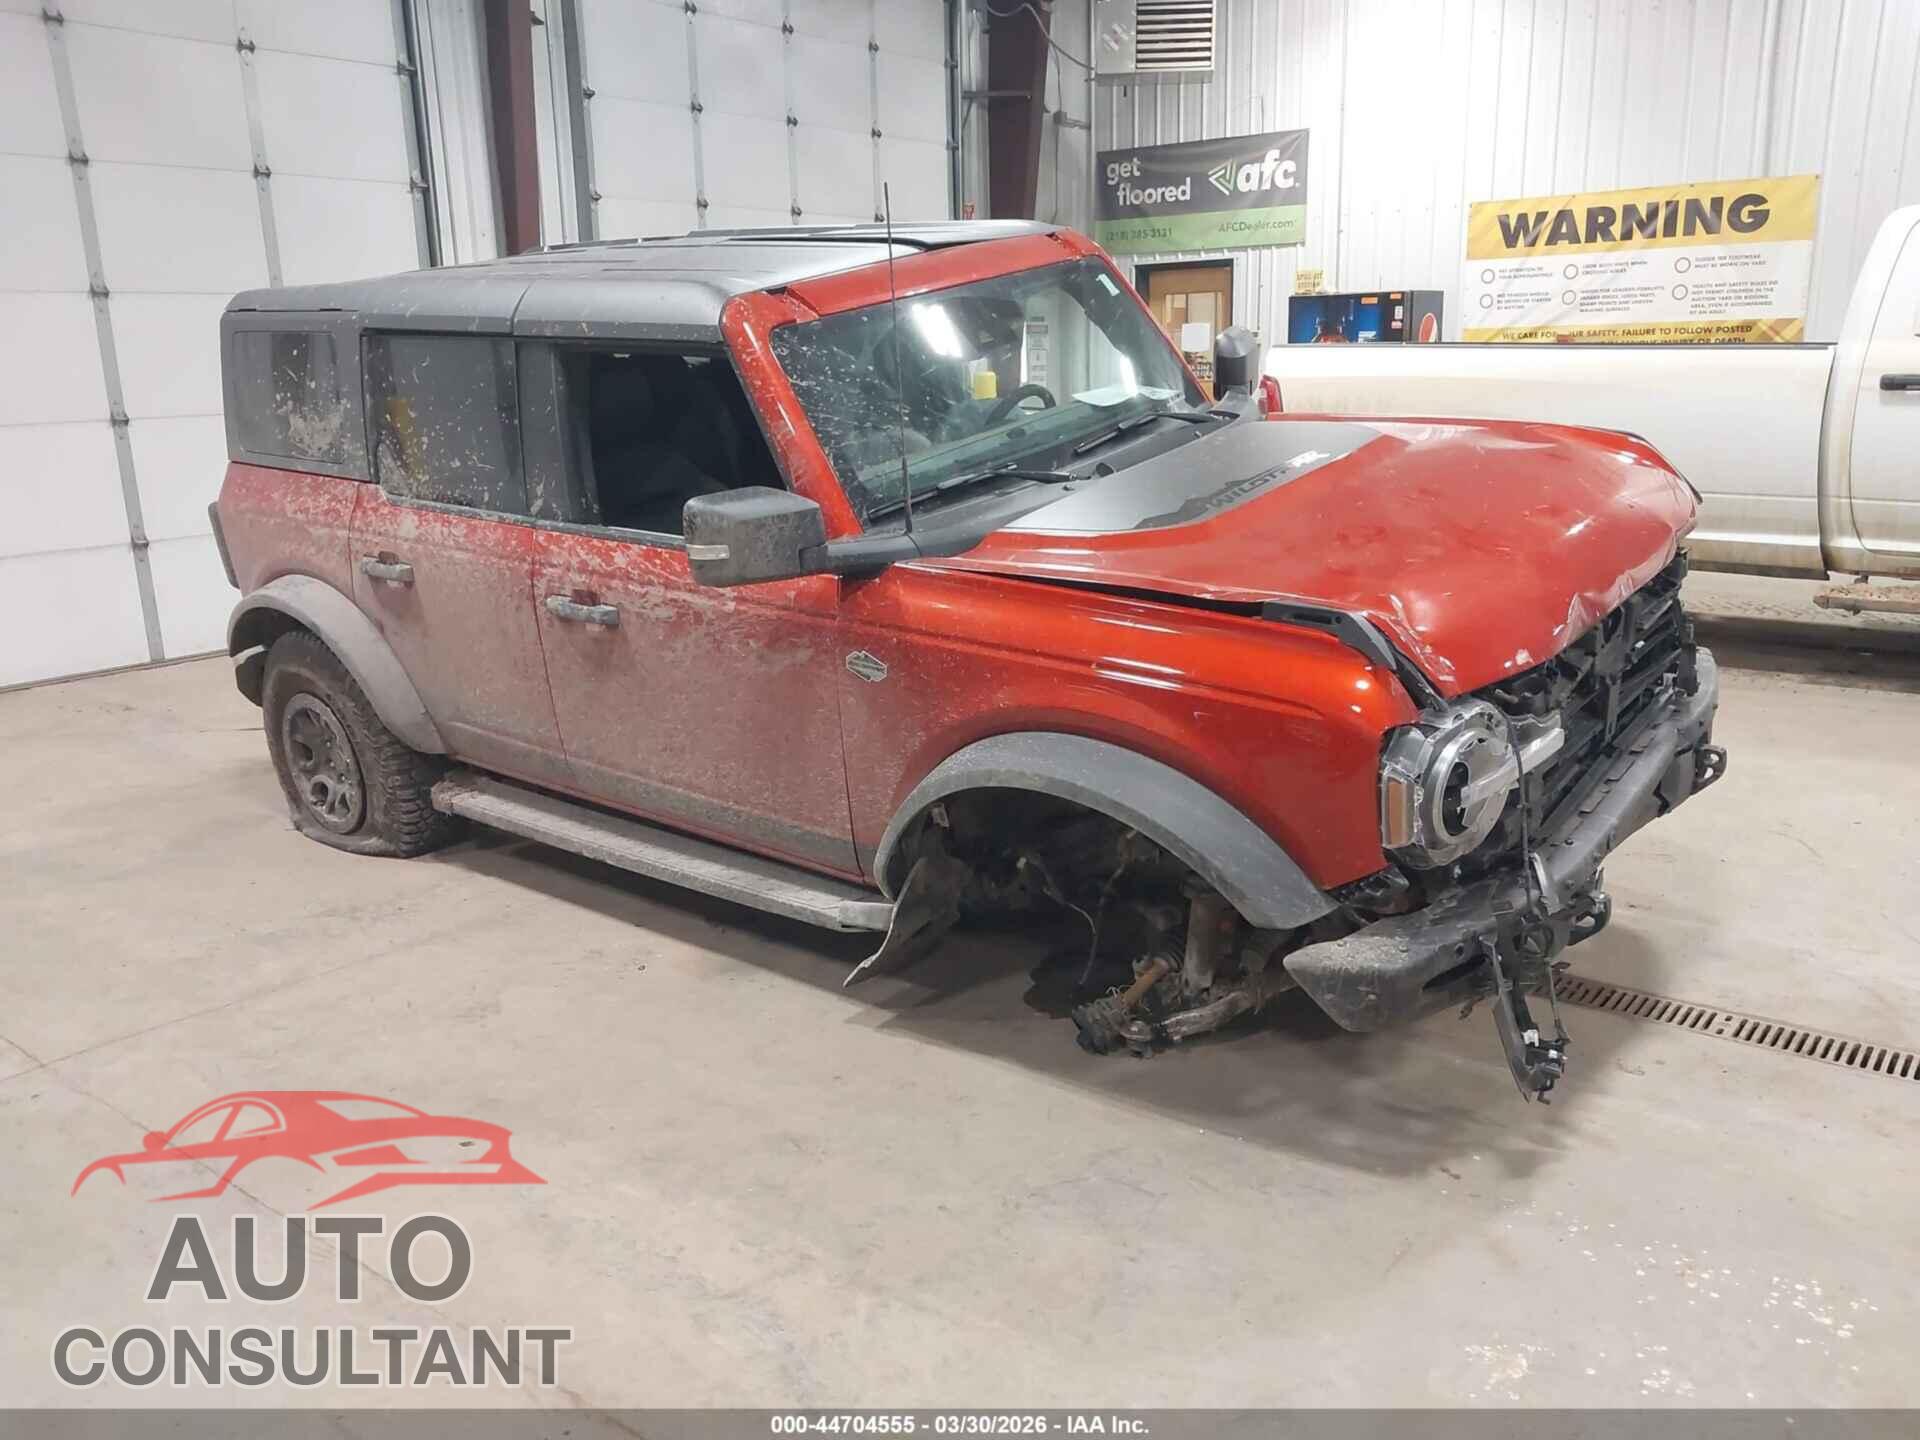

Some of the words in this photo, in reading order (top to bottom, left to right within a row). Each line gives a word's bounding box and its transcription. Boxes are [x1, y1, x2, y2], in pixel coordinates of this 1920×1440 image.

[1106, 157, 1141, 185] get
[1117, 176, 1191, 206] floored
[1497, 193, 1770, 249] WARNING
[1622, 327, 1656, 336] FAILURE
[1660, 327, 1672, 336] TO
[1674, 326, 1712, 335] FOLLOW
[1716, 324, 1752, 334] POSTED
